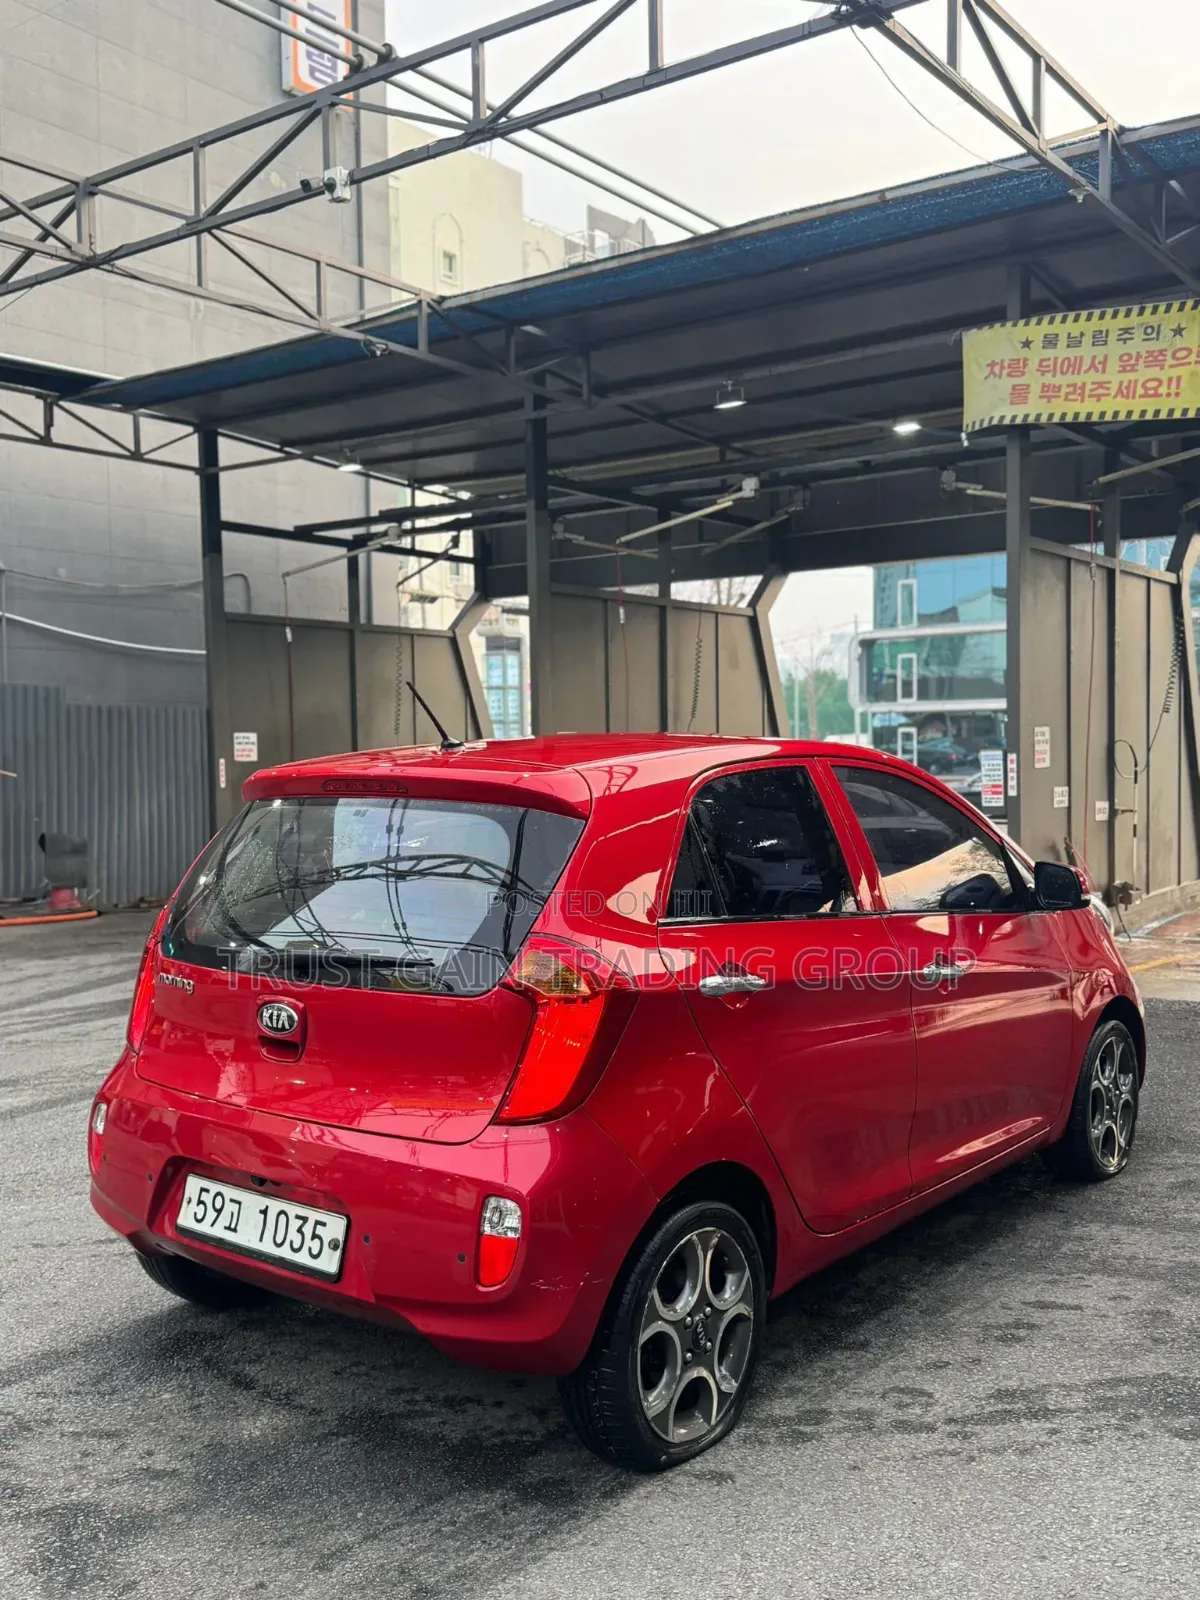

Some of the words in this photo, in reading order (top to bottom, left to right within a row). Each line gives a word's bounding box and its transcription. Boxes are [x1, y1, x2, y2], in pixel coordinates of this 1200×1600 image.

[984, 357, 1029, 380] 차량
[1036, 352, 1108, 378] 뒤에서
[1117, 346, 1200, 375] 앞쪽으
[1009, 383, 1031, 406] 물
[1038, 375, 1182, 404] 뿌려주세요!!
[159, 973, 194, 994] morning
[262, 1009, 290, 1030] KIA
[258, 1205, 328, 1260] 1035
